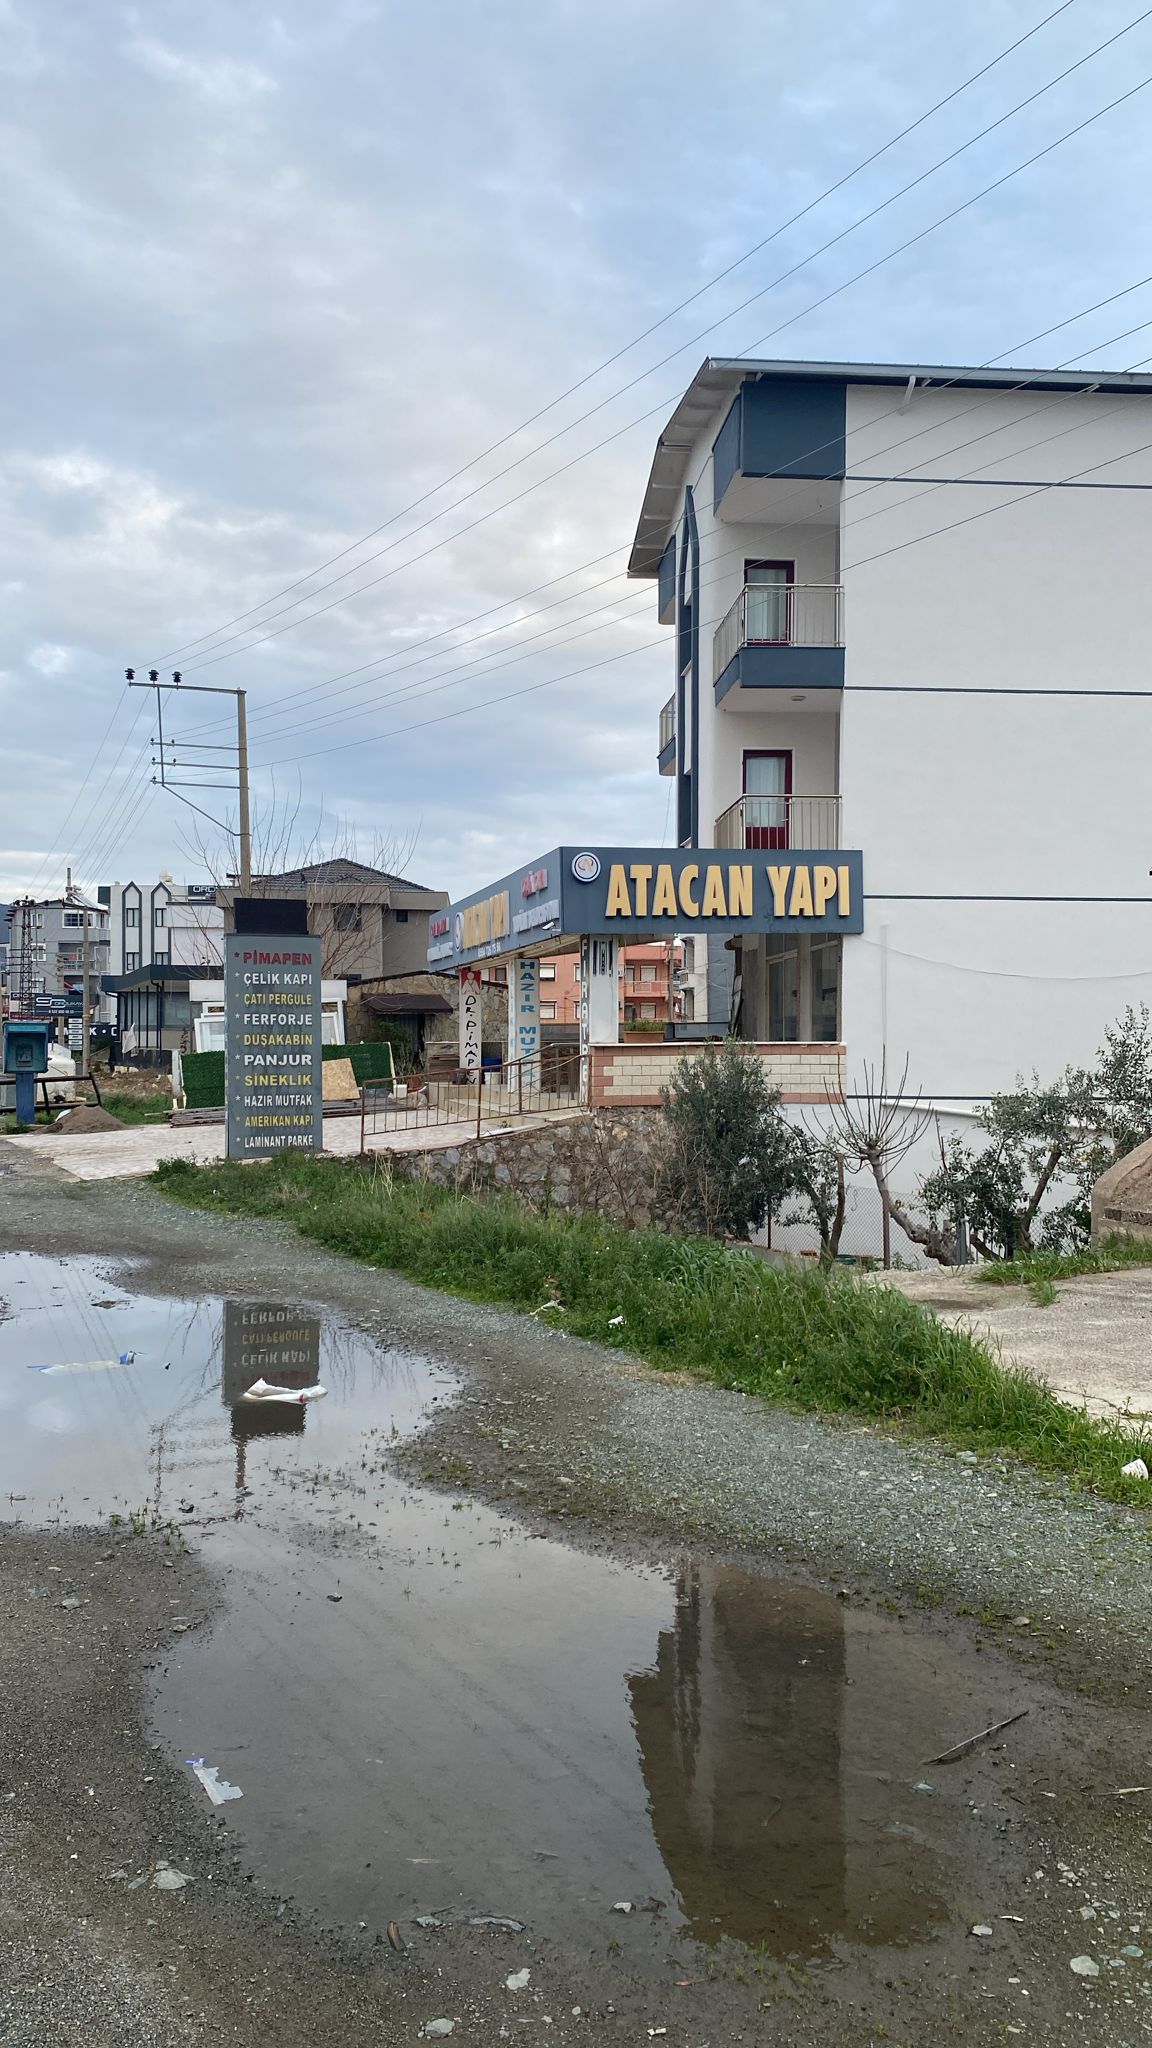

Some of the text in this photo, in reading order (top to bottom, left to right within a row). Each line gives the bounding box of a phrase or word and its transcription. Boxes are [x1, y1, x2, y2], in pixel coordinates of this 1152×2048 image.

[605, 864, 753, 917] ATACAN
[766, 865, 851, 917] YAPI
[243, 949, 312, 965] PİMAPEN
[243, 971, 312, 987] ÇELİK KAPI
[520, 961, 535, 1013] HAZIR
[244, 993, 312, 1007] ÇATI PERGULE
[243, 1013, 313, 1025] FERFORJE
[243, 1032, 313, 1047] DUŞAKABİN
[244, 1054, 312, 1066] PANJUR
[244, 1072, 312, 1086] SİNEKLİK
[244, 1094, 312, 1107] HAZIR MUTFAK
[244, 1114, 313, 1127] AMERİKAN KAPI
[244, 1133, 313, 1148] LAMİNANT PARKE
